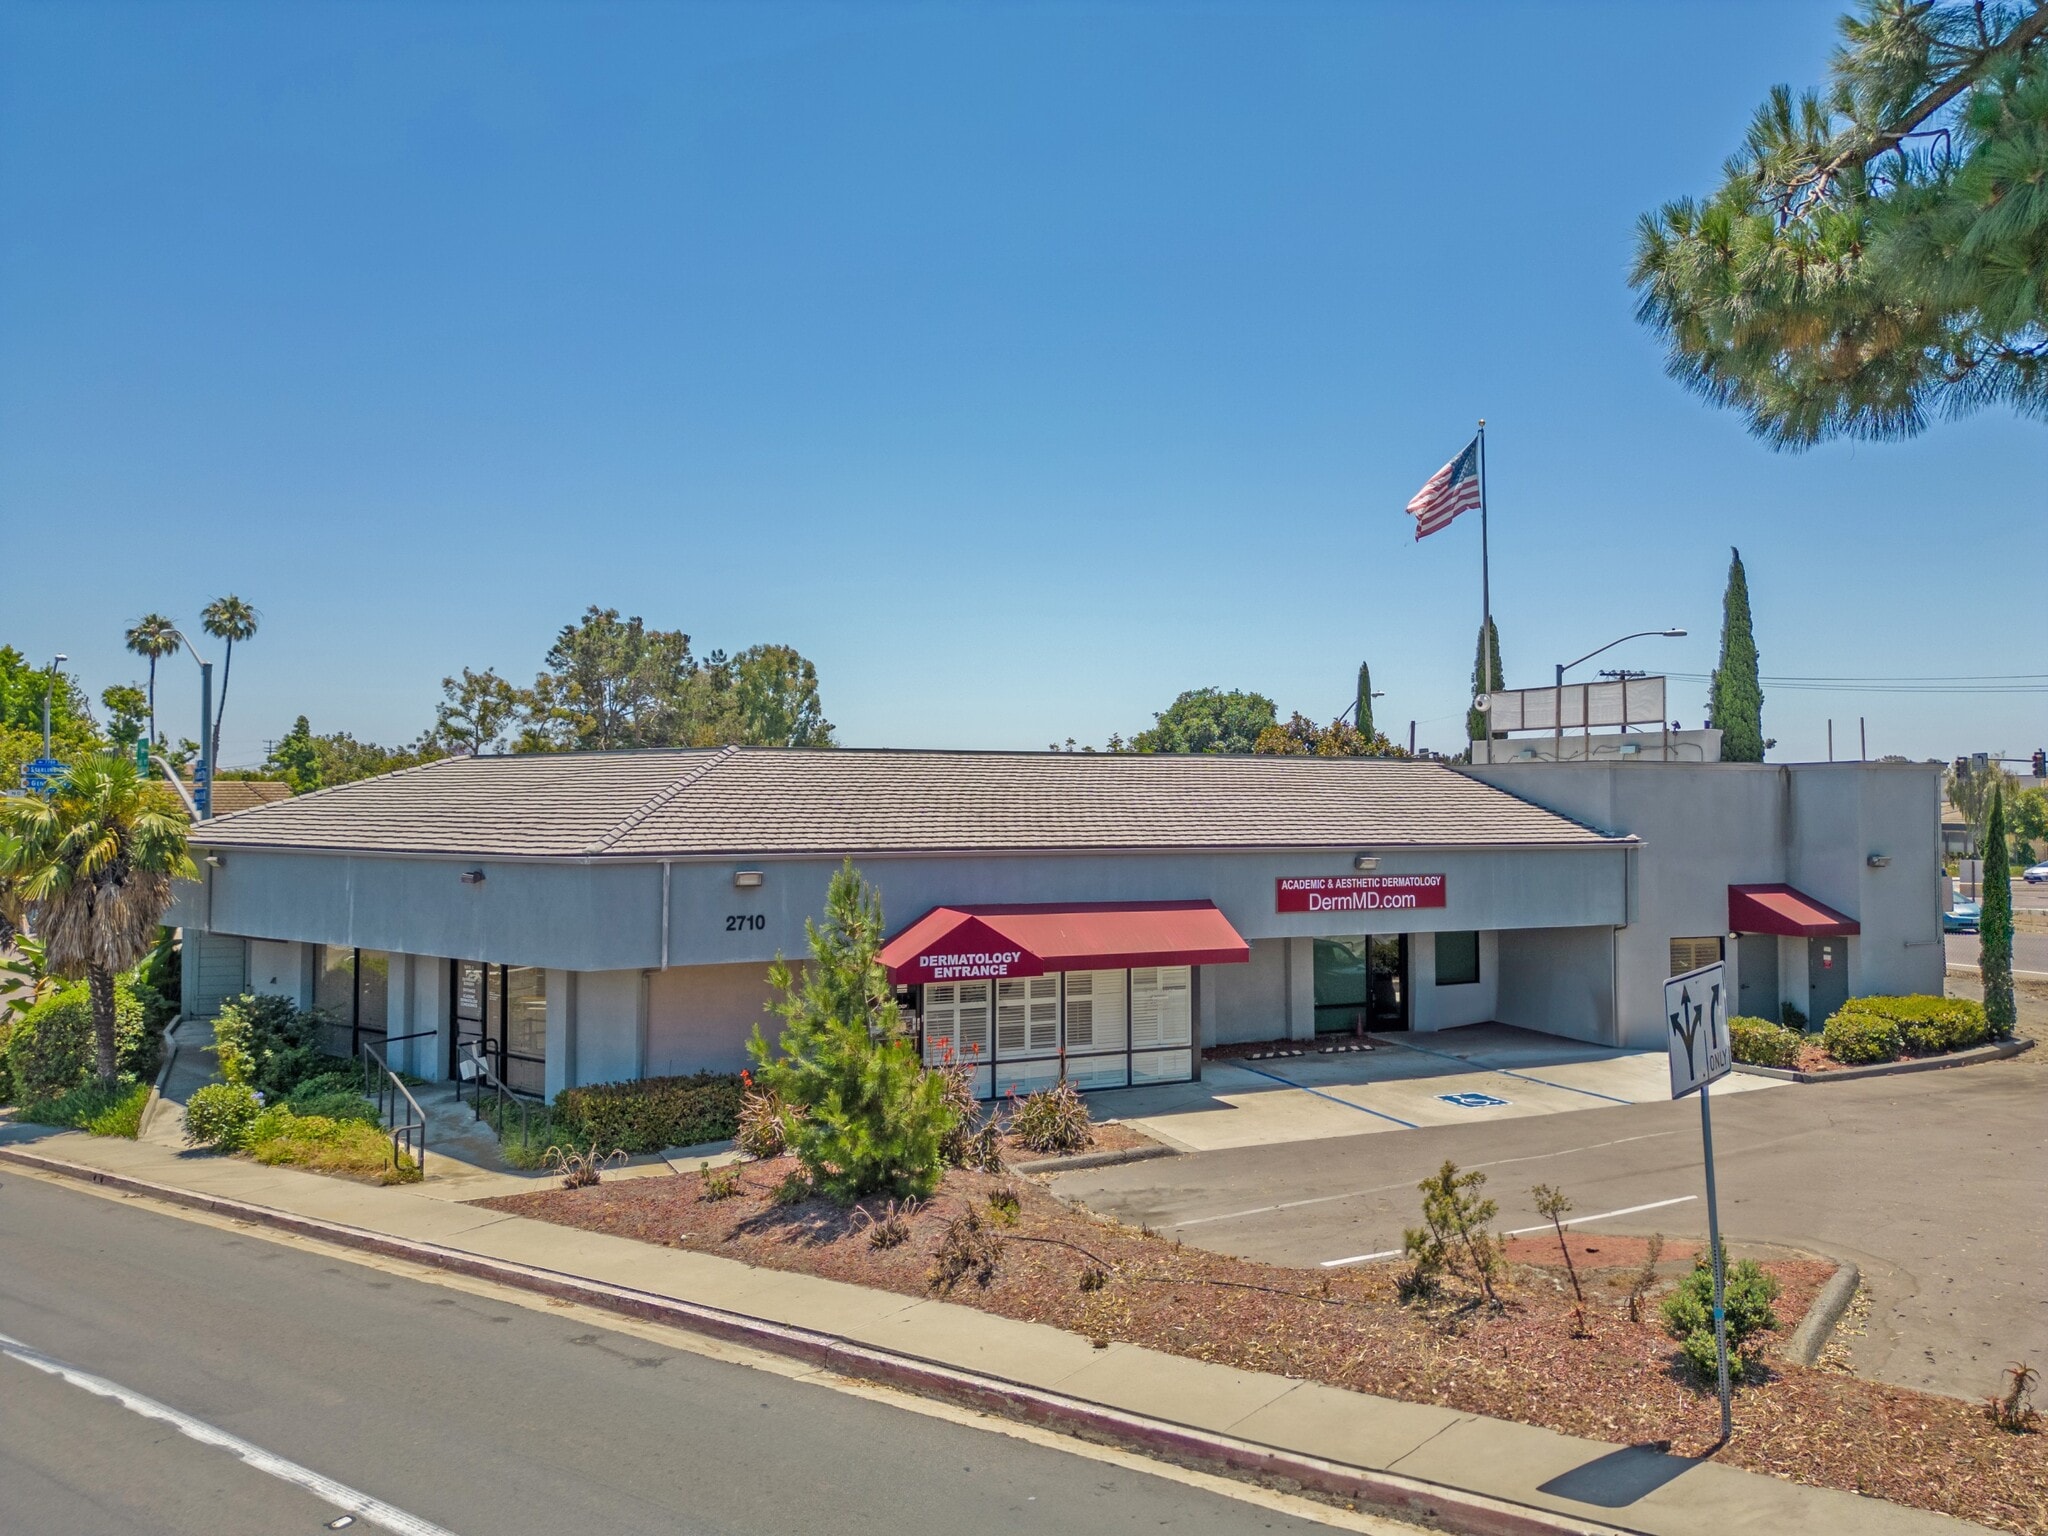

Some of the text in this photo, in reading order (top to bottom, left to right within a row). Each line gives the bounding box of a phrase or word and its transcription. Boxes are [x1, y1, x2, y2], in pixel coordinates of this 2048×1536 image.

[1281, 876, 1441, 890] ACADEMIC & AESTHETIC DERMATOLOGY
[1309, 892, 1416, 911] DermMD.com
[726, 914, 766, 931] 2710
[920, 951, 1021, 967] DERMATOLOGY
[934, 964, 1008, 979] ENTRANCE
[1709, 1048, 1728, 1072] ONLY
